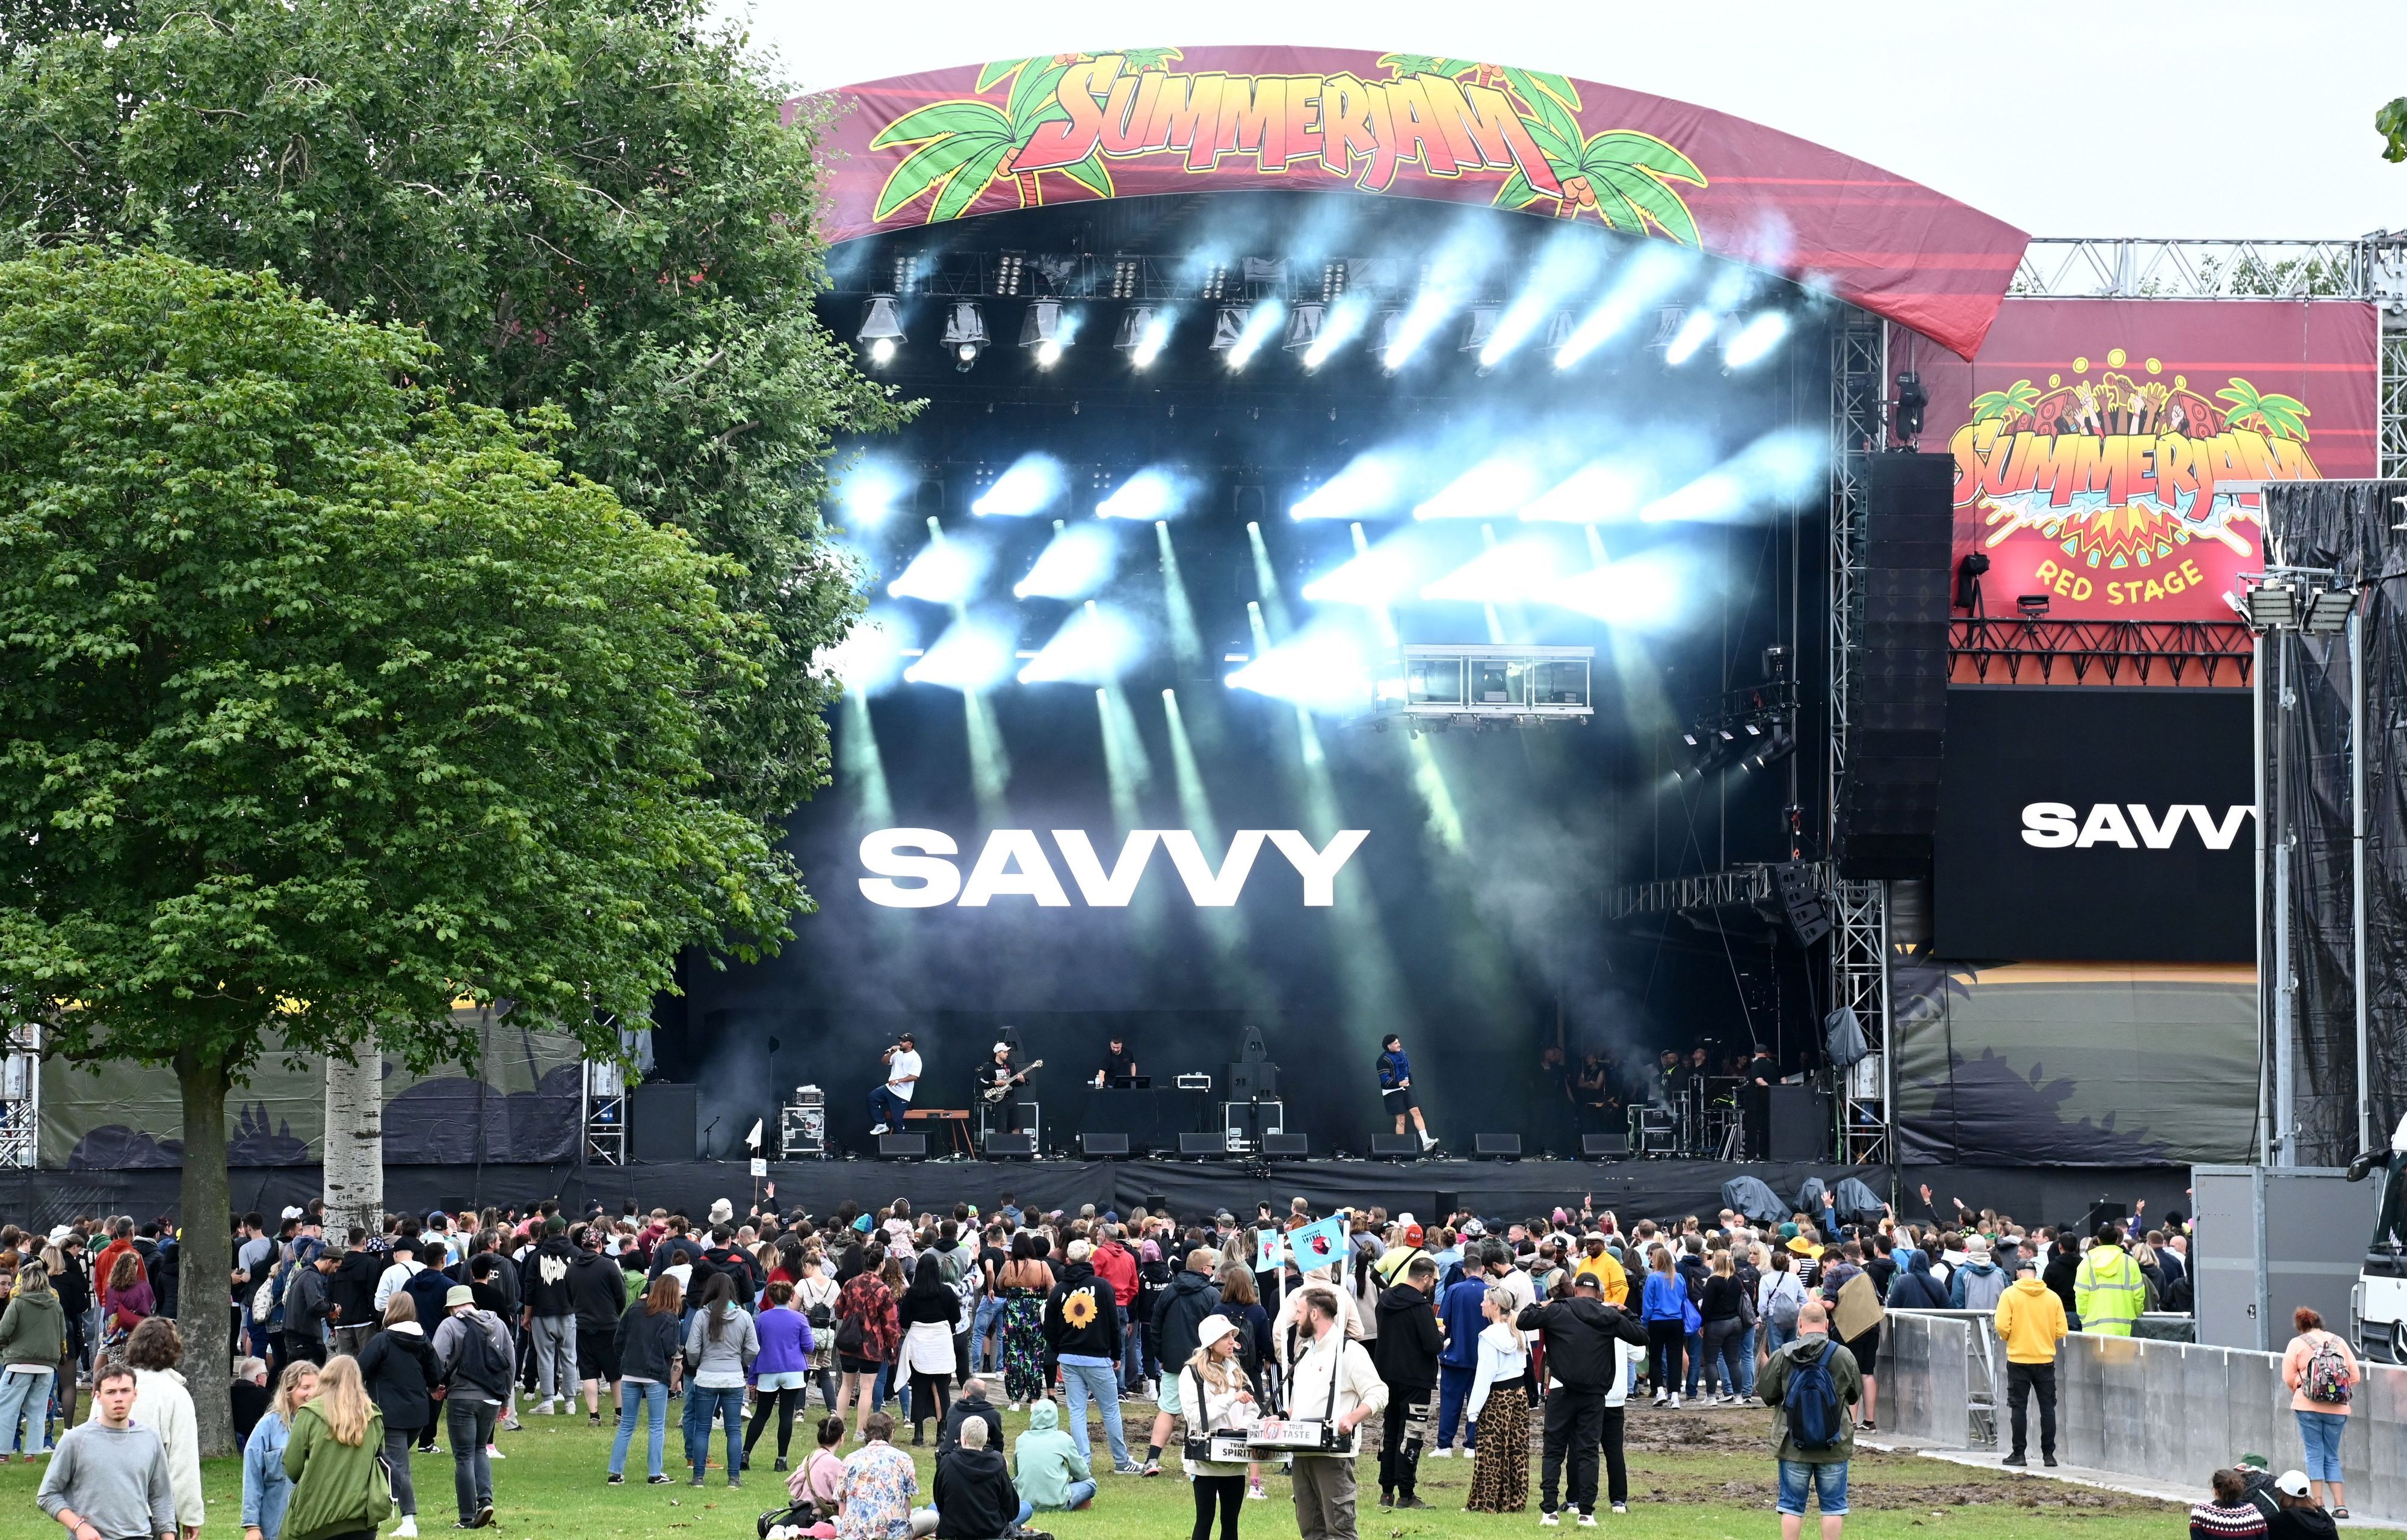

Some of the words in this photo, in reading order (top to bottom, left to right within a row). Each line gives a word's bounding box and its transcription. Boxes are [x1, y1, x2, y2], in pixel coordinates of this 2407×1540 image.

[1009, 53, 1565, 199] SUMMERJAM
[2035, 560, 2093, 601] RED
[2106, 558, 2204, 605] STAGE
[2021, 802, 2255, 850] SAVV
[858, 827, 1371, 908] SAVVY
[1302, 1233, 1321, 1244] SPIRIT
[1249, 1430, 1264, 1438] SPIRIT
[1283, 1430, 1310, 1439] TASTE
[1223, 1448, 1252, 1458] SPIRIT
